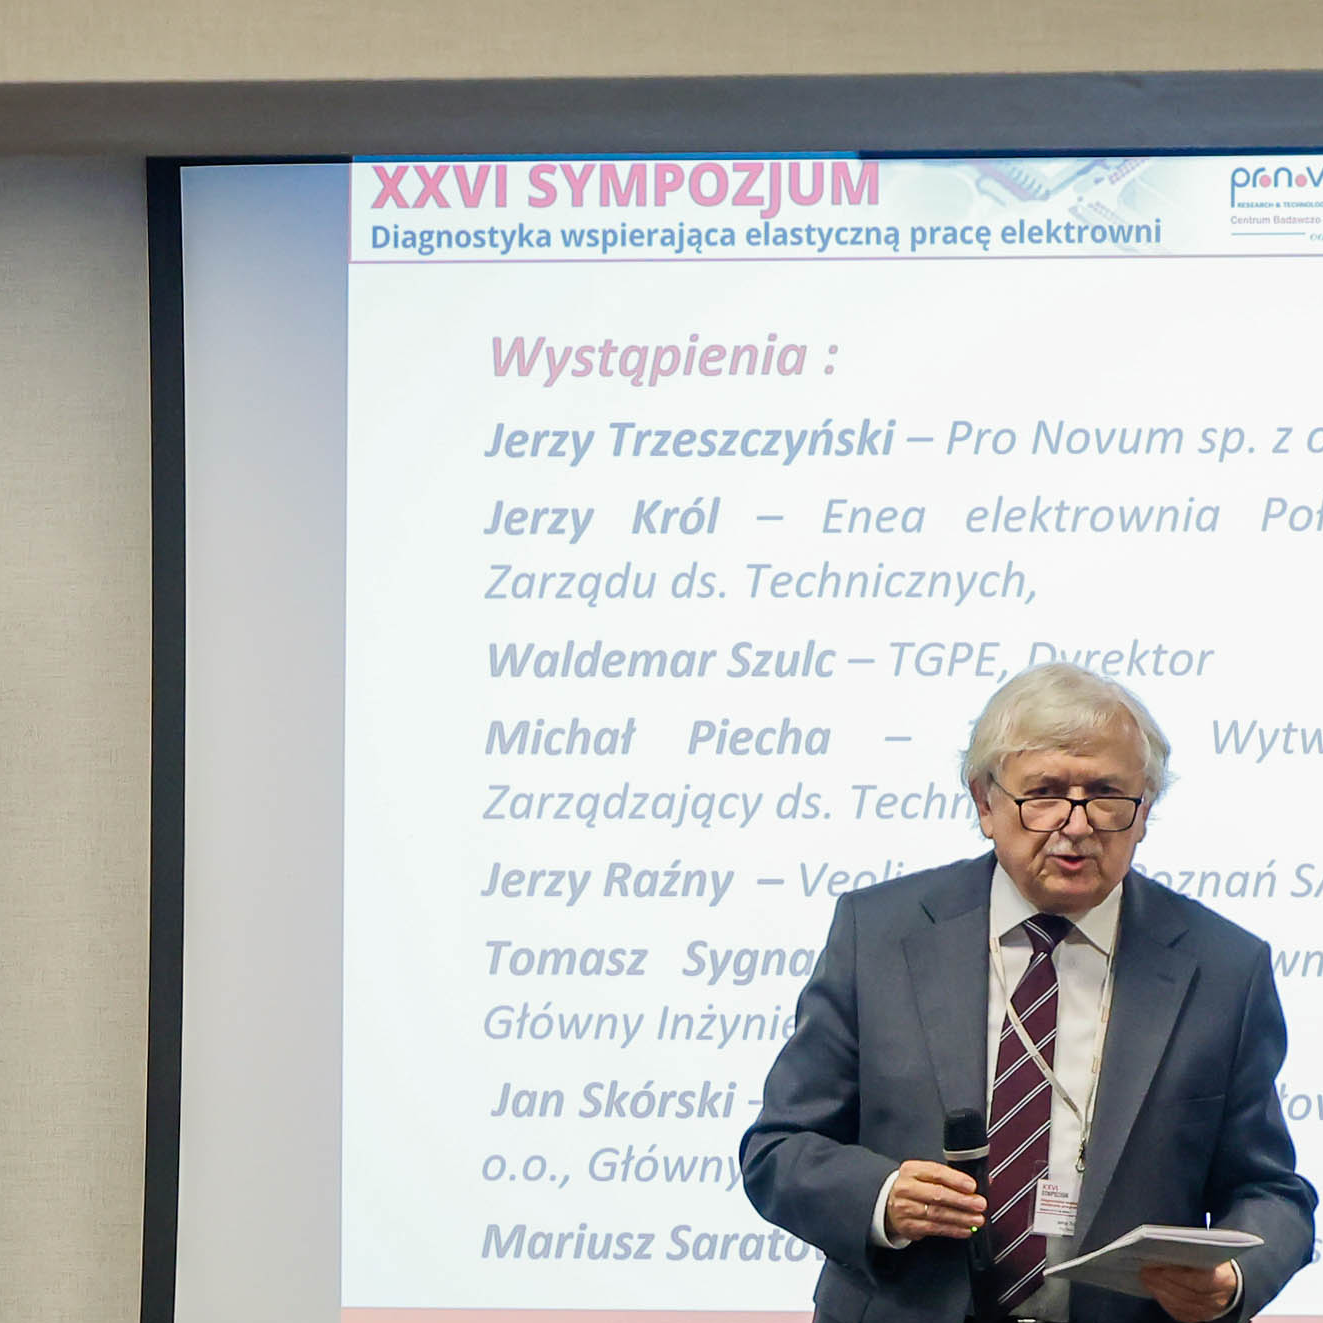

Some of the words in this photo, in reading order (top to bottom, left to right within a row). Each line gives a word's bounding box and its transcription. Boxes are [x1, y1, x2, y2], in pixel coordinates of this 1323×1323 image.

[372, 165, 506, 208] XXVI
[528, 161, 880, 219] SYMPOZJUM
[372, 223, 551, 256] Diagnostyka
[560, 222, 735, 254] wspierająca
[746, 221, 899, 253] elastyczną
[911, 226, 991, 252] pracę
[1001, 218, 1160, 244] elektrowni
[492, 333, 807, 388] Wystąpienia
[484, 423, 595, 467] Jerzy
[609, 418, 896, 466] Trzeszczyński
[947, 421, 1016, 455] Pro
[1032, 420, 1183, 454] Novum
[1197, 427, 1254, 463] sp.
[483, 500, 594, 544] Jerzy
[632, 496, 721, 535] Król
[823, 499, 925, 533] Enea
[966, 495, 1221, 533] elektrownia
[484, 561, 656, 607] Zarządu
[672, 561, 725, 598] ds.
[747, 560, 1035, 607] Technicznych,
[489, 640, 717, 678] Waldemar
[727, 640, 837, 678] Szulc
[890, 642, 1007, 683] TGPE,
[485, 717, 636, 756] Michał
[688, 717, 831, 755] Piecha
[482, 782, 763, 828] Zarządzający
[776, 782, 830, 819] ds.
[481, 862, 591, 907] Jerzy
[603, 859, 734, 907] Raźny
[486, 941, 648, 976] Tomasz
[484, 1001, 644, 1049] Główny
[491, 1083, 564, 1118] Jan
[579, 1080, 737, 1119] Skórski
[482, 1155, 569, 1189] o.o.,
[482, 1223, 655, 1260] Mariusz
